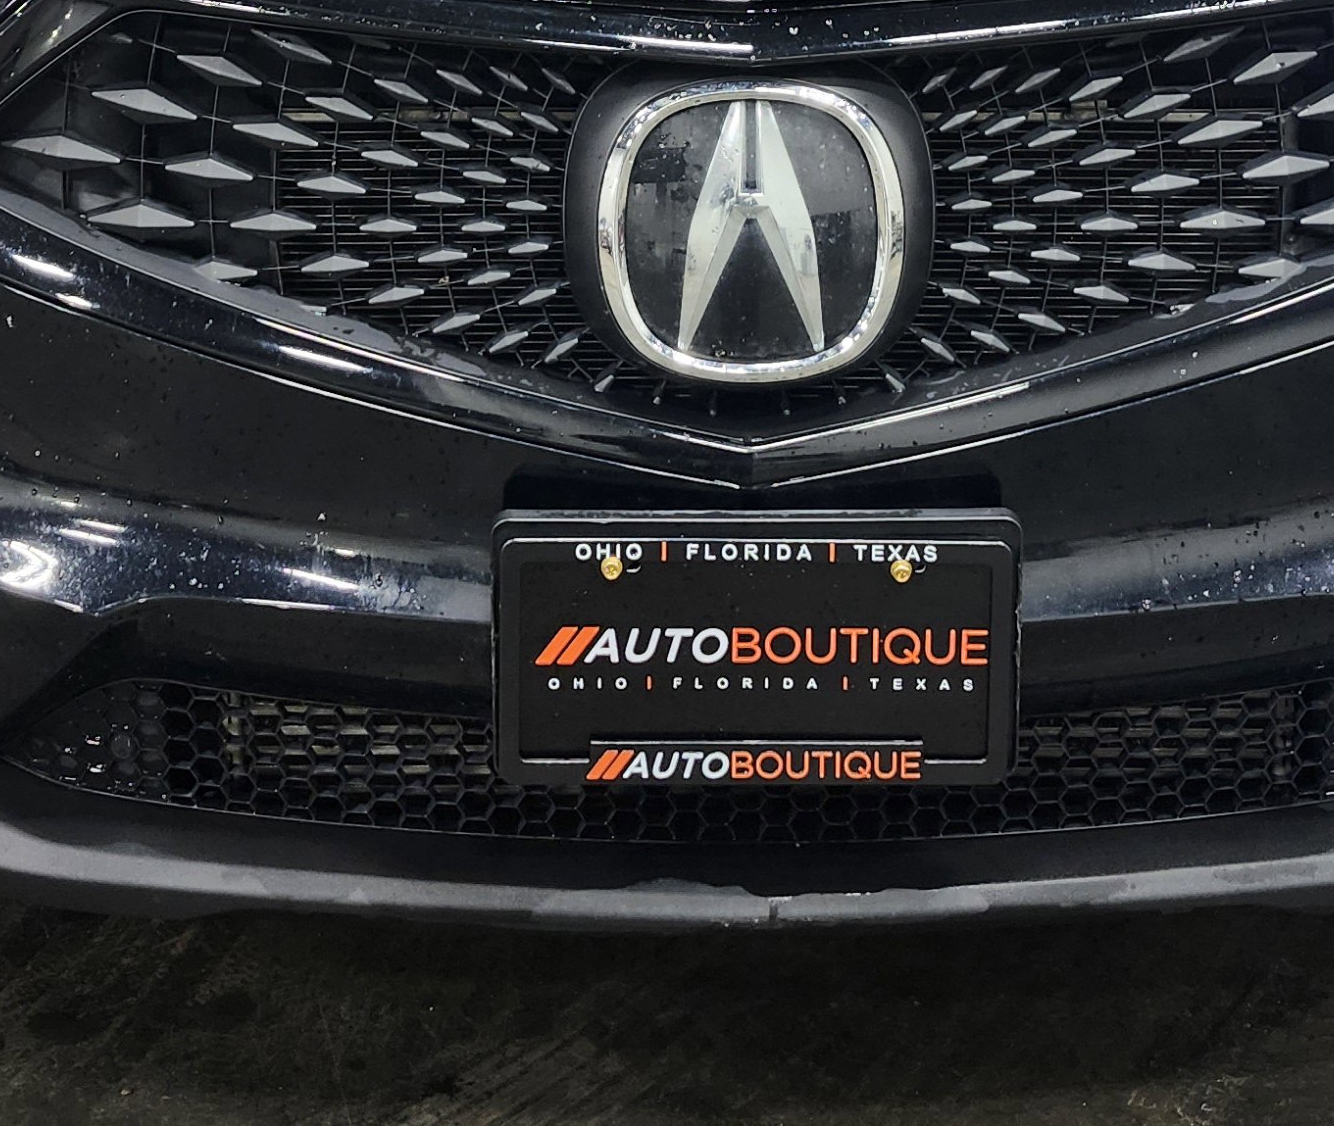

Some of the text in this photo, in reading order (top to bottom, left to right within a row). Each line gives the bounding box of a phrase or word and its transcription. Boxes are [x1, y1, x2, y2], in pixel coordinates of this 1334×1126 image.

[575, 542, 939, 564] OHIO FLORIDA TEXAS
[584, 626, 989, 666] AUTOBOUTIQUE
[547, 676, 975, 693] OHIO FLORIDA TEXAS
[621, 749, 923, 781] AUTOBOUTIQUE
